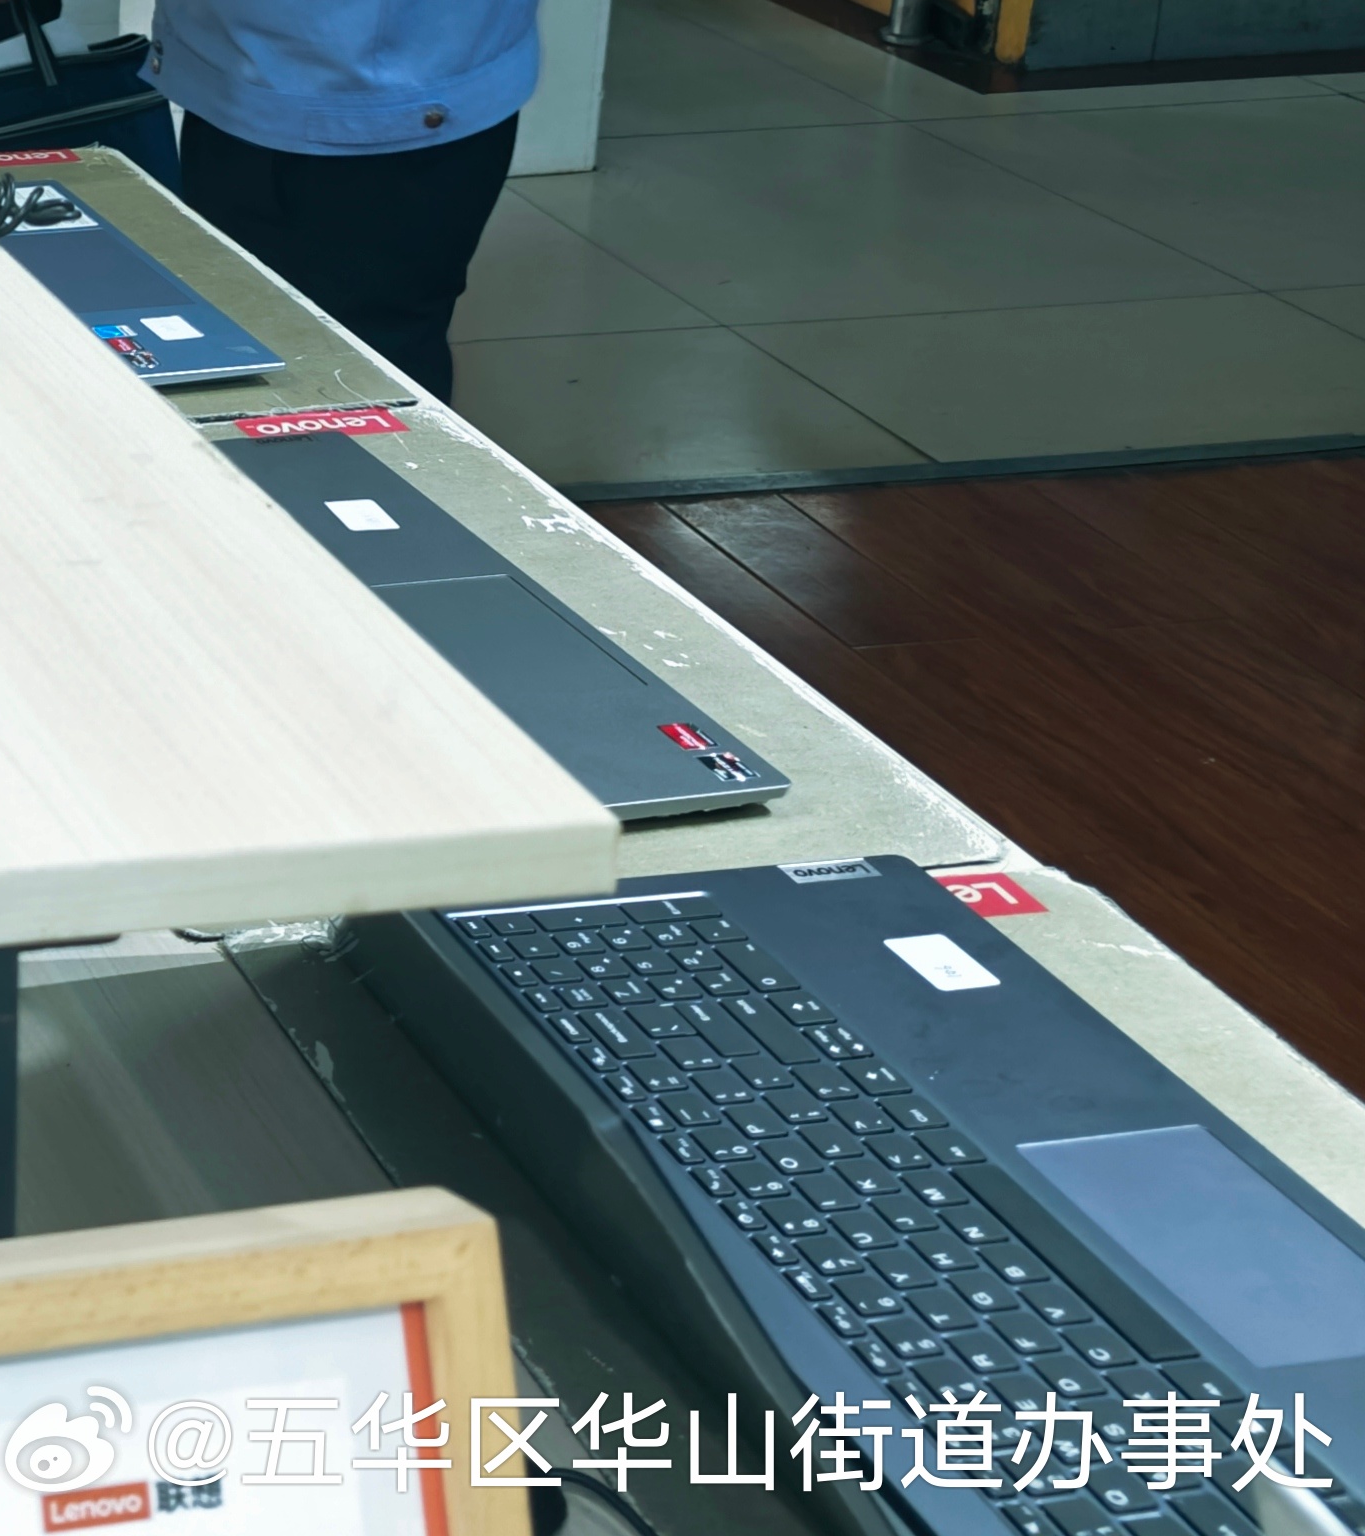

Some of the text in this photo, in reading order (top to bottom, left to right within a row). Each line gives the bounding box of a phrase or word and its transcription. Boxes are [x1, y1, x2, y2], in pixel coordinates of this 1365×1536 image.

[256, 409, 392, 435] Lenovo
[793, 863, 871, 877] Lenovo
[49, 1476, 225, 1525] Lenovo 联想
